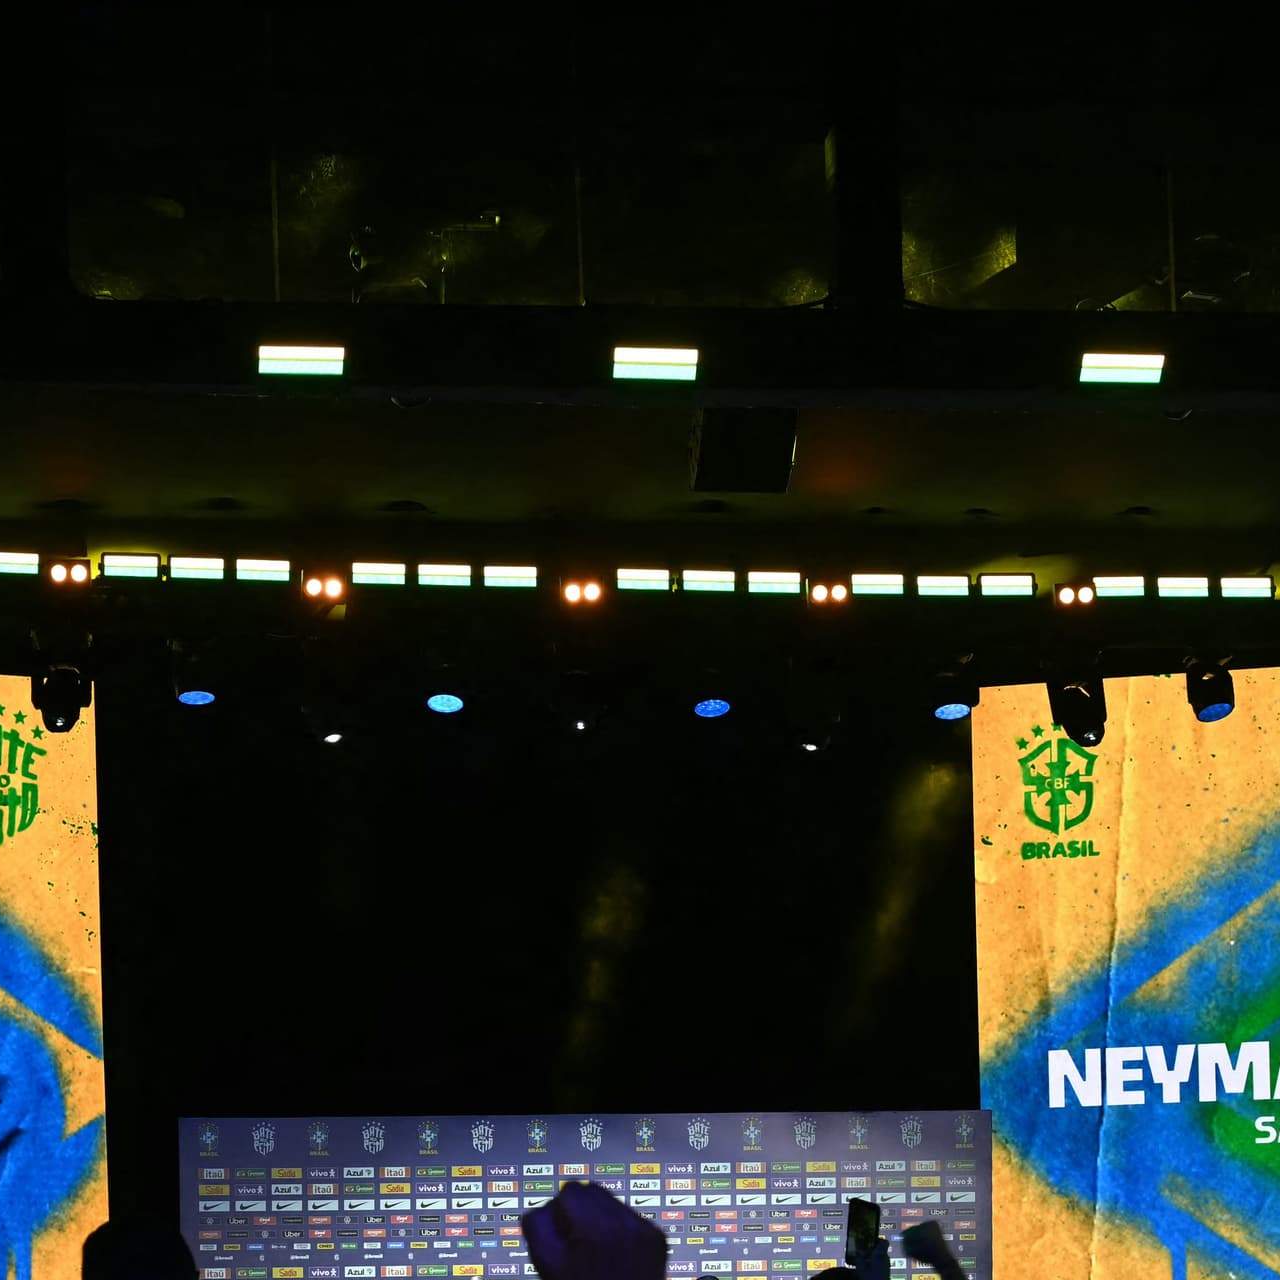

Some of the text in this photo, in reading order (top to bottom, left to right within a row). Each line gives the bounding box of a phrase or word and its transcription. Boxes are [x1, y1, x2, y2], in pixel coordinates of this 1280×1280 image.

[1021, 840, 1100, 860] BRASIL
[490, 1167, 508, 1175] vivo
[703, 1164, 720, 1172] Azul
[310, 1169, 328, 1177] vivo
[346, 1169, 364, 1177] Azul
[632, 1181, 650, 1189] Azul
[808, 1179, 825, 1187] Azul
[238, 1186, 256, 1194] vivo
[274, 1185, 291, 1194] Azul
[418, 1184, 437, 1192] vivo
[454, 1184, 472, 1192] Azul
[491, 1265, 510, 1273] vivo
[668, 1263, 687, 1271] vivo
[311, 1268, 330, 1276] vivo
[347, 1268, 365, 1276] Azul
